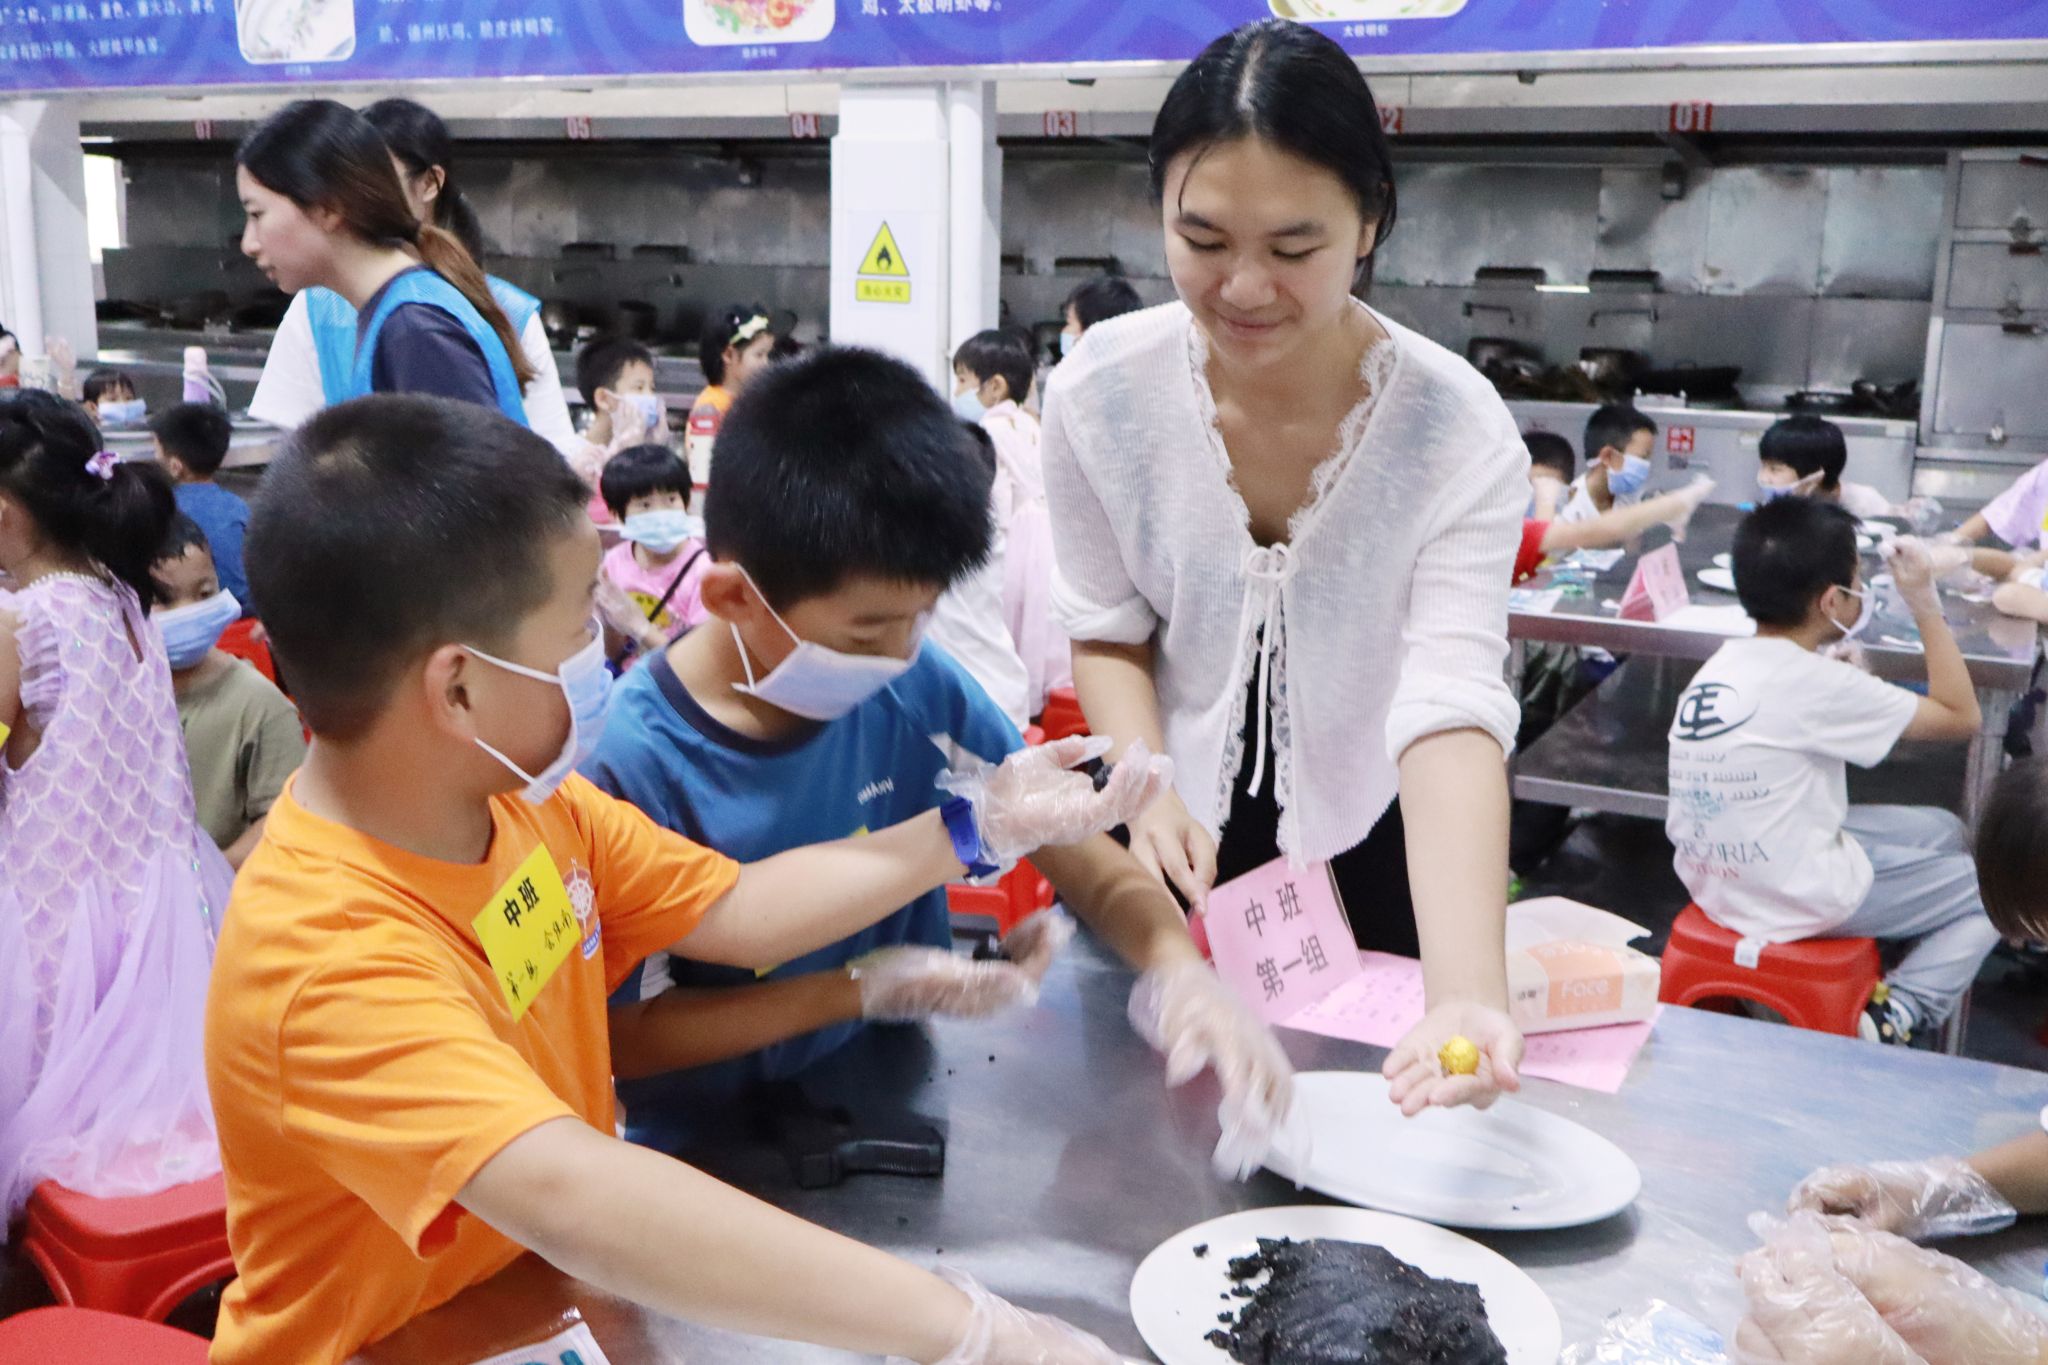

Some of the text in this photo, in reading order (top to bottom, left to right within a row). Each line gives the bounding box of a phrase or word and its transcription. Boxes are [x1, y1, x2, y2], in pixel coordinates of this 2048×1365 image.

[792, 112, 817, 138] 04
[1046, 110, 1074, 137] 03
[1676, 102, 1706, 131] 01
[503, 876, 540, 928] 中班
[1244, 881, 1303, 937] 中班
[1256, 935, 1329, 1002] 第一组
